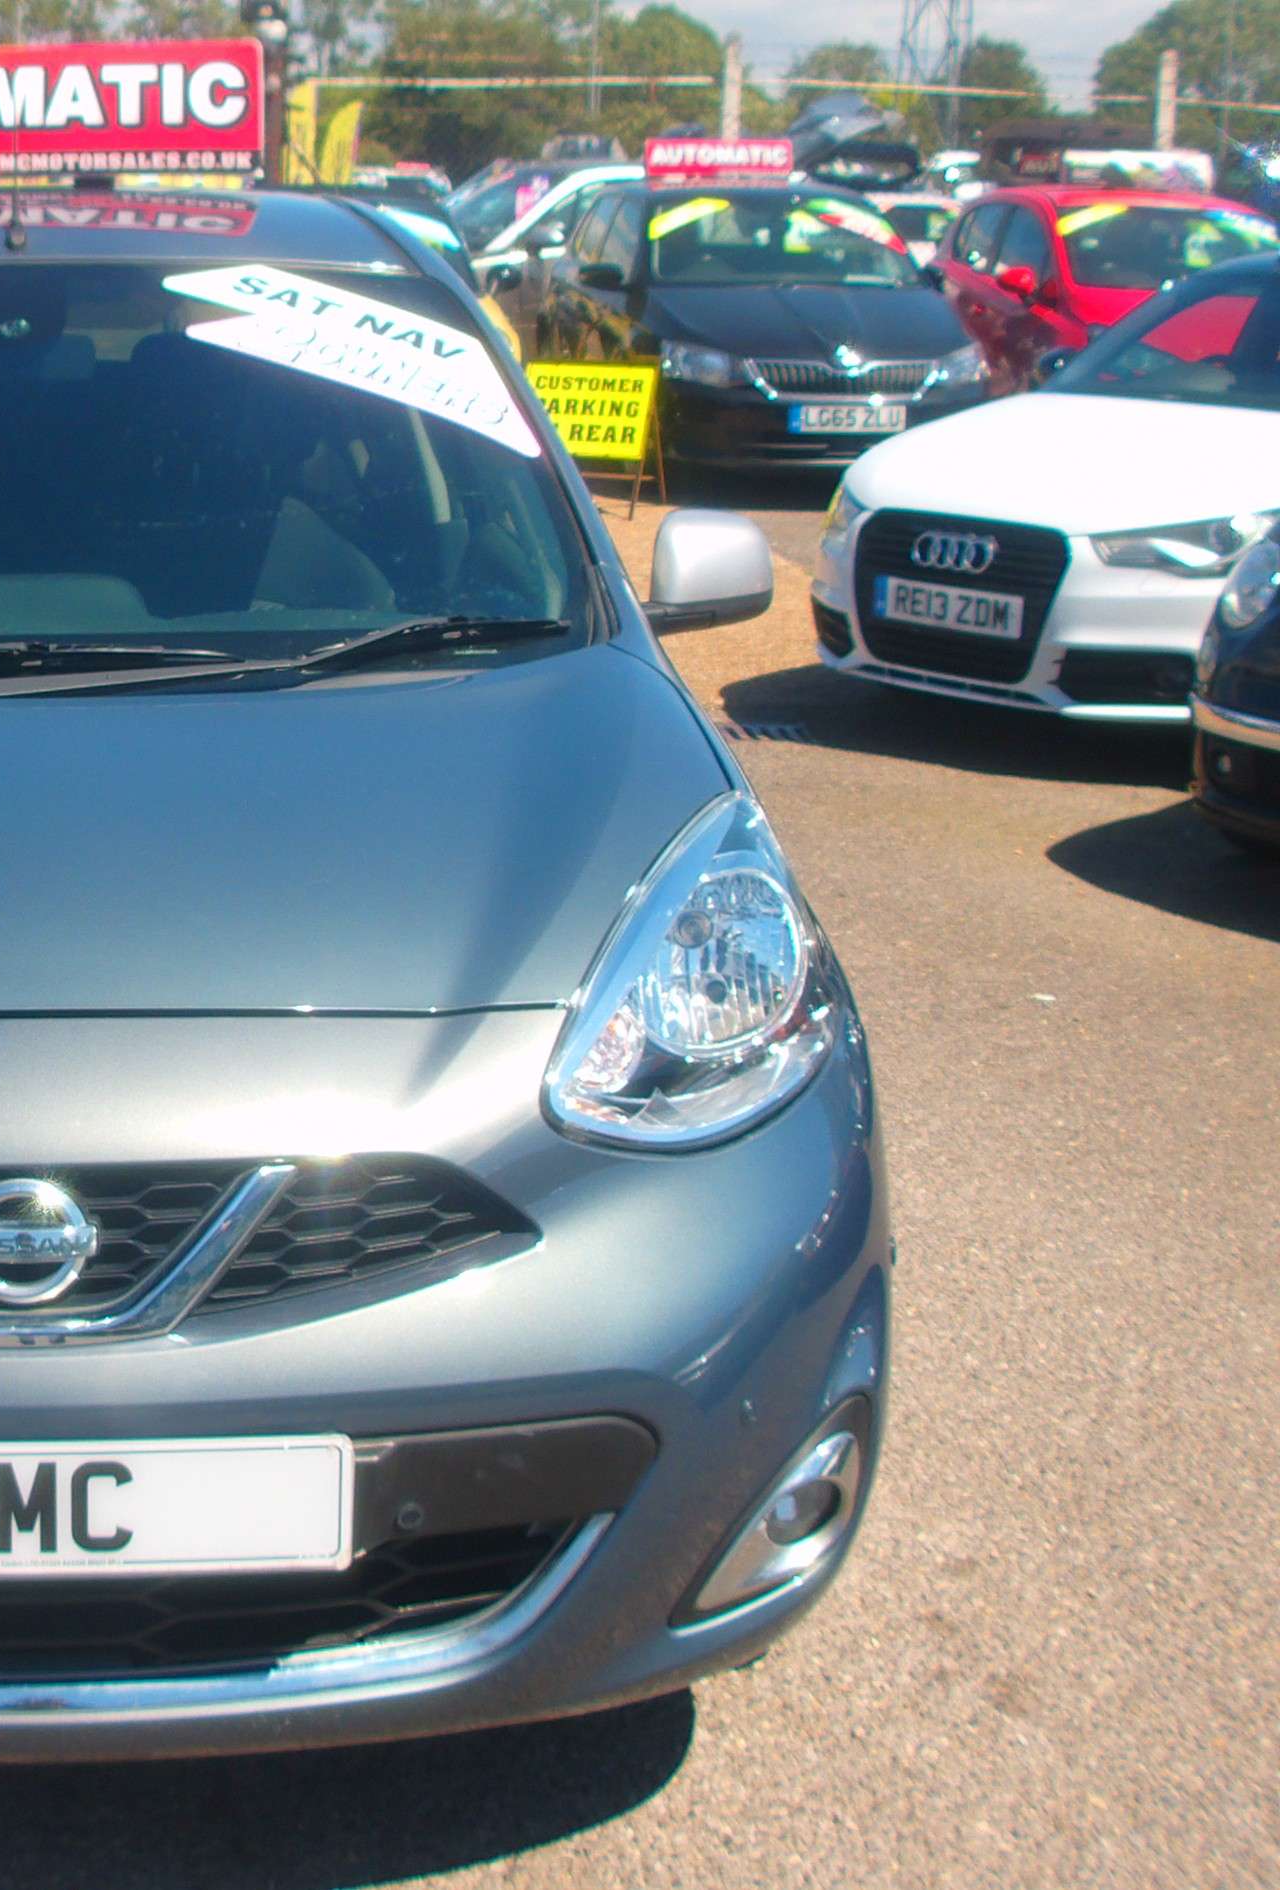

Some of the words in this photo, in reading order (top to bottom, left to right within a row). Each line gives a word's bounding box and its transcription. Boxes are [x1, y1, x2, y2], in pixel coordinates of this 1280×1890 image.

[650, 143, 789, 167] AUTOMATIC
[233, 275, 343, 316] SAT
[353, 313, 468, 360] NAV
[535, 375, 644, 393] CUSTOMER
[540, 398, 640, 418] ARKING
[568, 424, 637, 444] REAR
[894, 584, 950, 620] RE13
